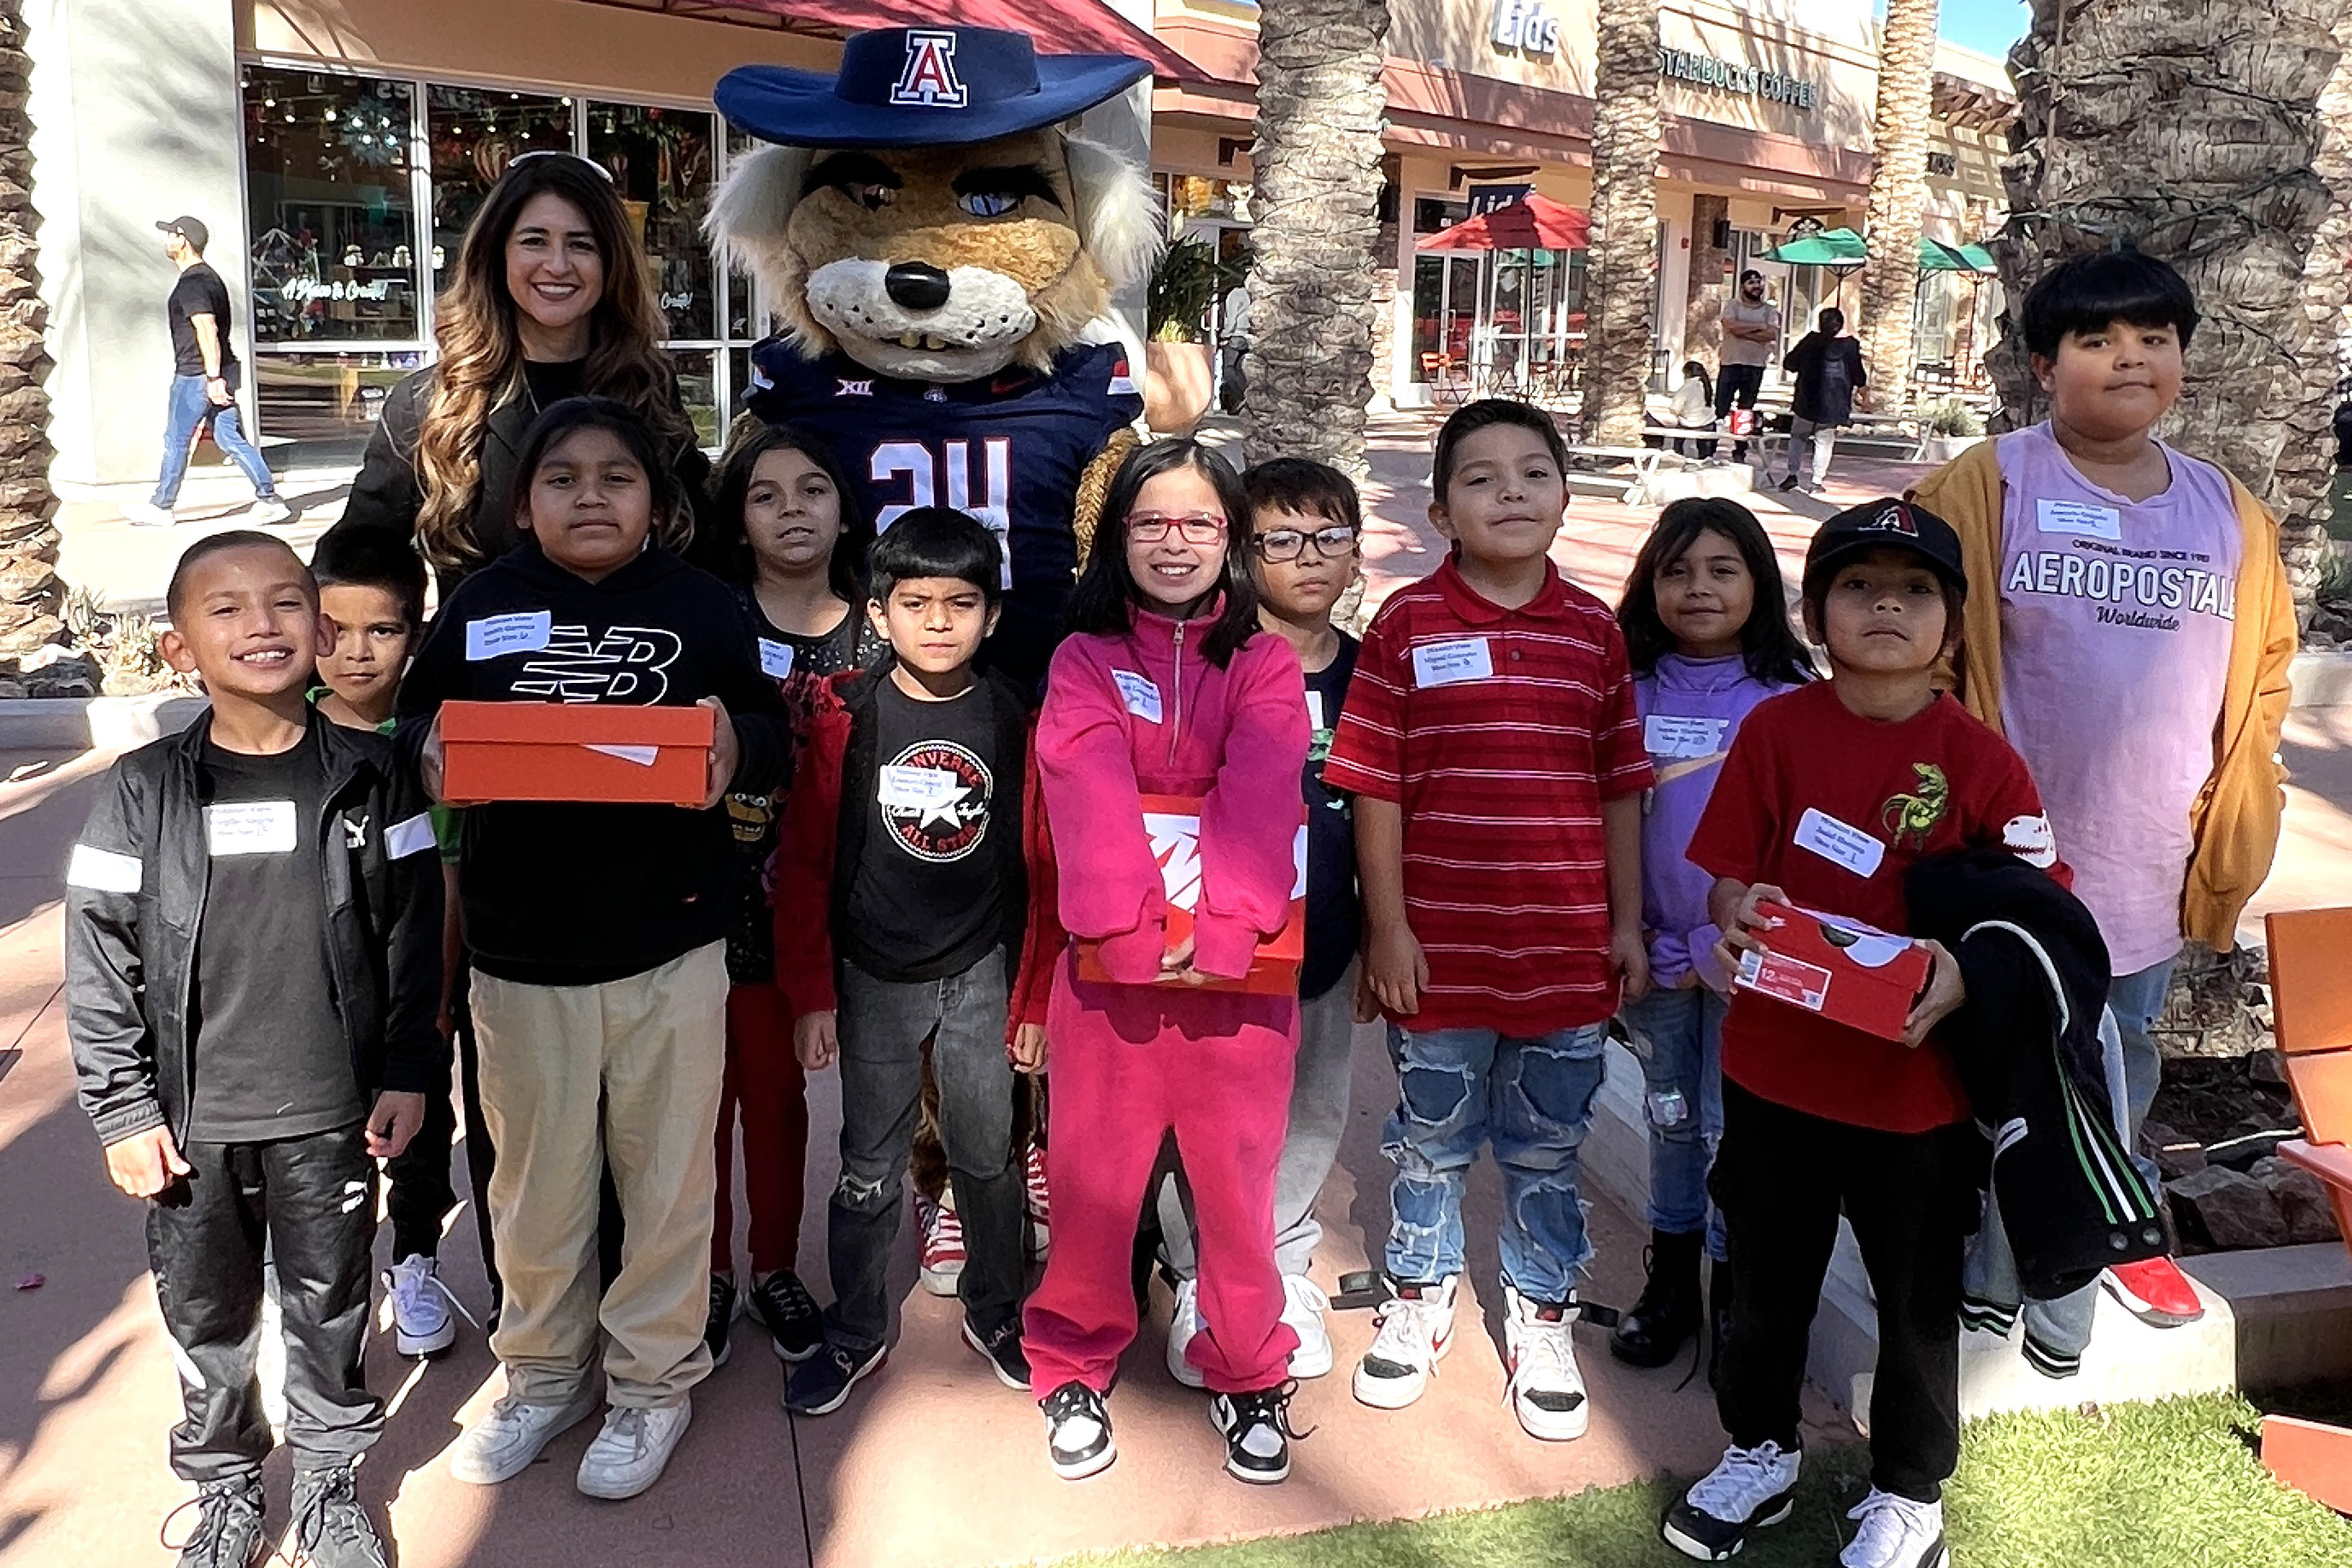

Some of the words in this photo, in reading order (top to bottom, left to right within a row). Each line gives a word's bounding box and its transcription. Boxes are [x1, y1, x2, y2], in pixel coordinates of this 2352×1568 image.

[1491, 0, 1559, 55] Lids
[889, 29, 967, 108] A
[1657, 46, 1759, 95] STARBUCKS
[1760, 71, 1817, 108] COFFEE
[1469, 195, 1514, 218] Lid
[867, 437, 1012, 590] 24
[2095, 606, 2182, 632] Worldwide
[1761, 967, 1778, 983] 12
